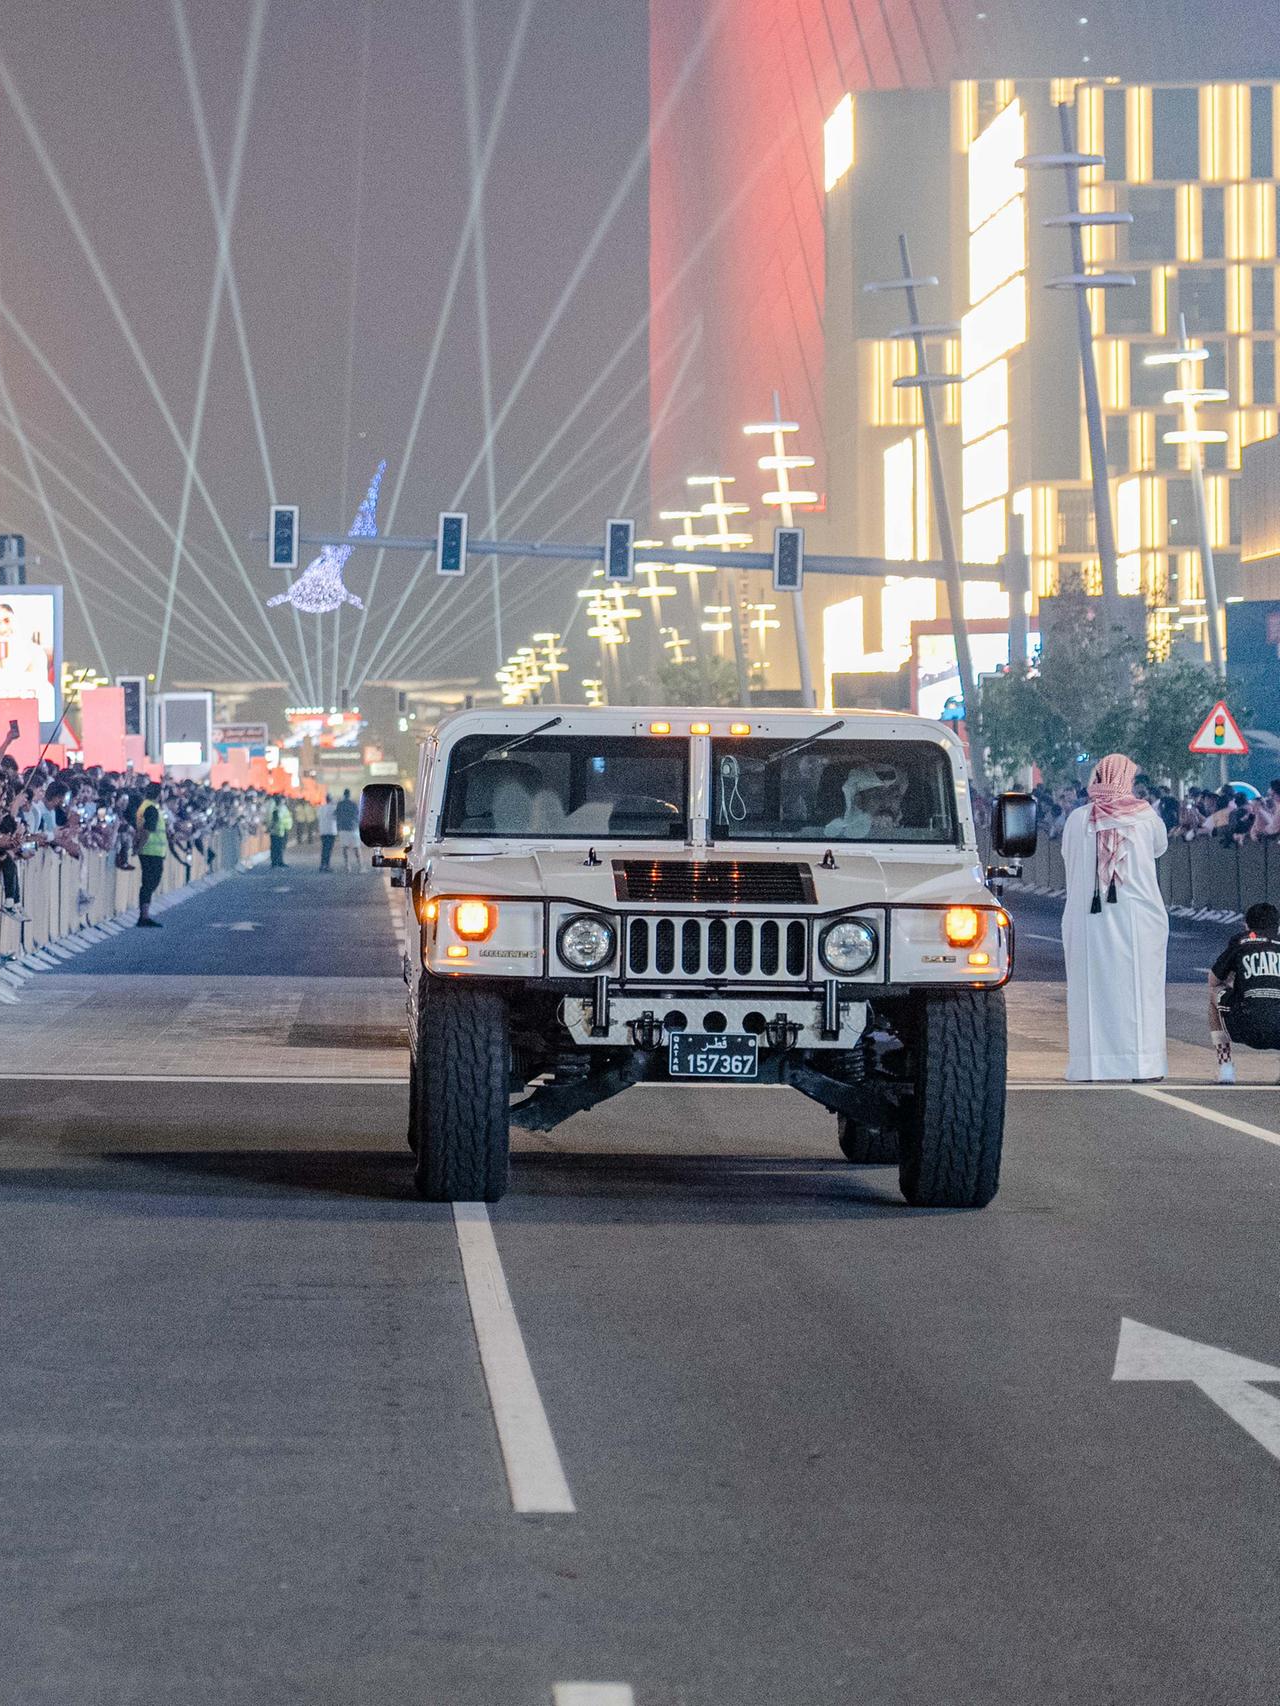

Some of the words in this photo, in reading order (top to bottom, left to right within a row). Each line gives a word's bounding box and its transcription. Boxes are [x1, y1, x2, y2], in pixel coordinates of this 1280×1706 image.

[1242, 951, 1280, 980] SCAR
[672, 1036, 680, 1072] QATAR
[700, 1036, 728, 1052] قطر
[687, 1054, 754, 1074] 157367
